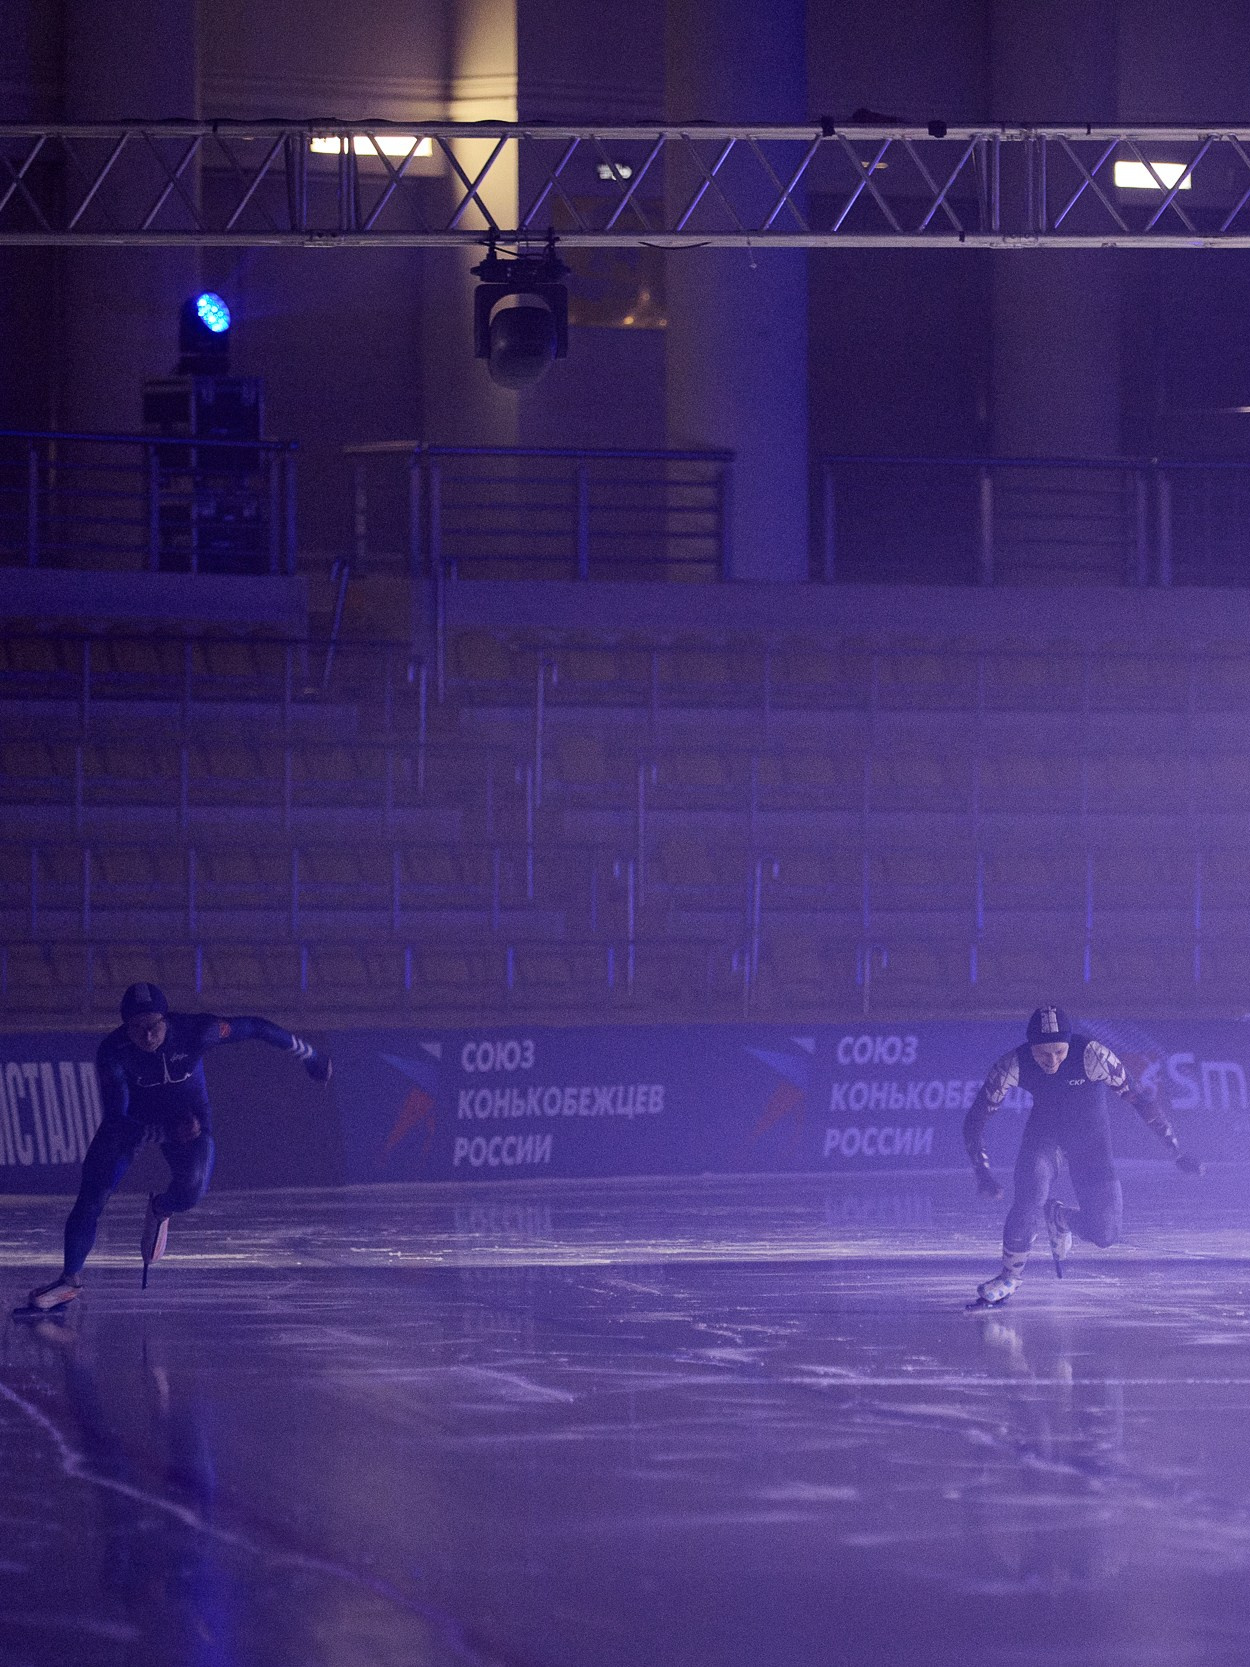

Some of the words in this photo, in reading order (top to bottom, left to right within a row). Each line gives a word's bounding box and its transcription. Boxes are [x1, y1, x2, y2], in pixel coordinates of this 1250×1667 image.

[460, 1038, 536, 1073] СОЮЗ
[836, 1034, 920, 1066] СОЮЗ
[456, 1083, 666, 1120] КОНЬКОБЕЖЦЕВ
[452, 1134, 552, 1168] РОССИИ
[822, 1127, 935, 1157] РОССИИ
